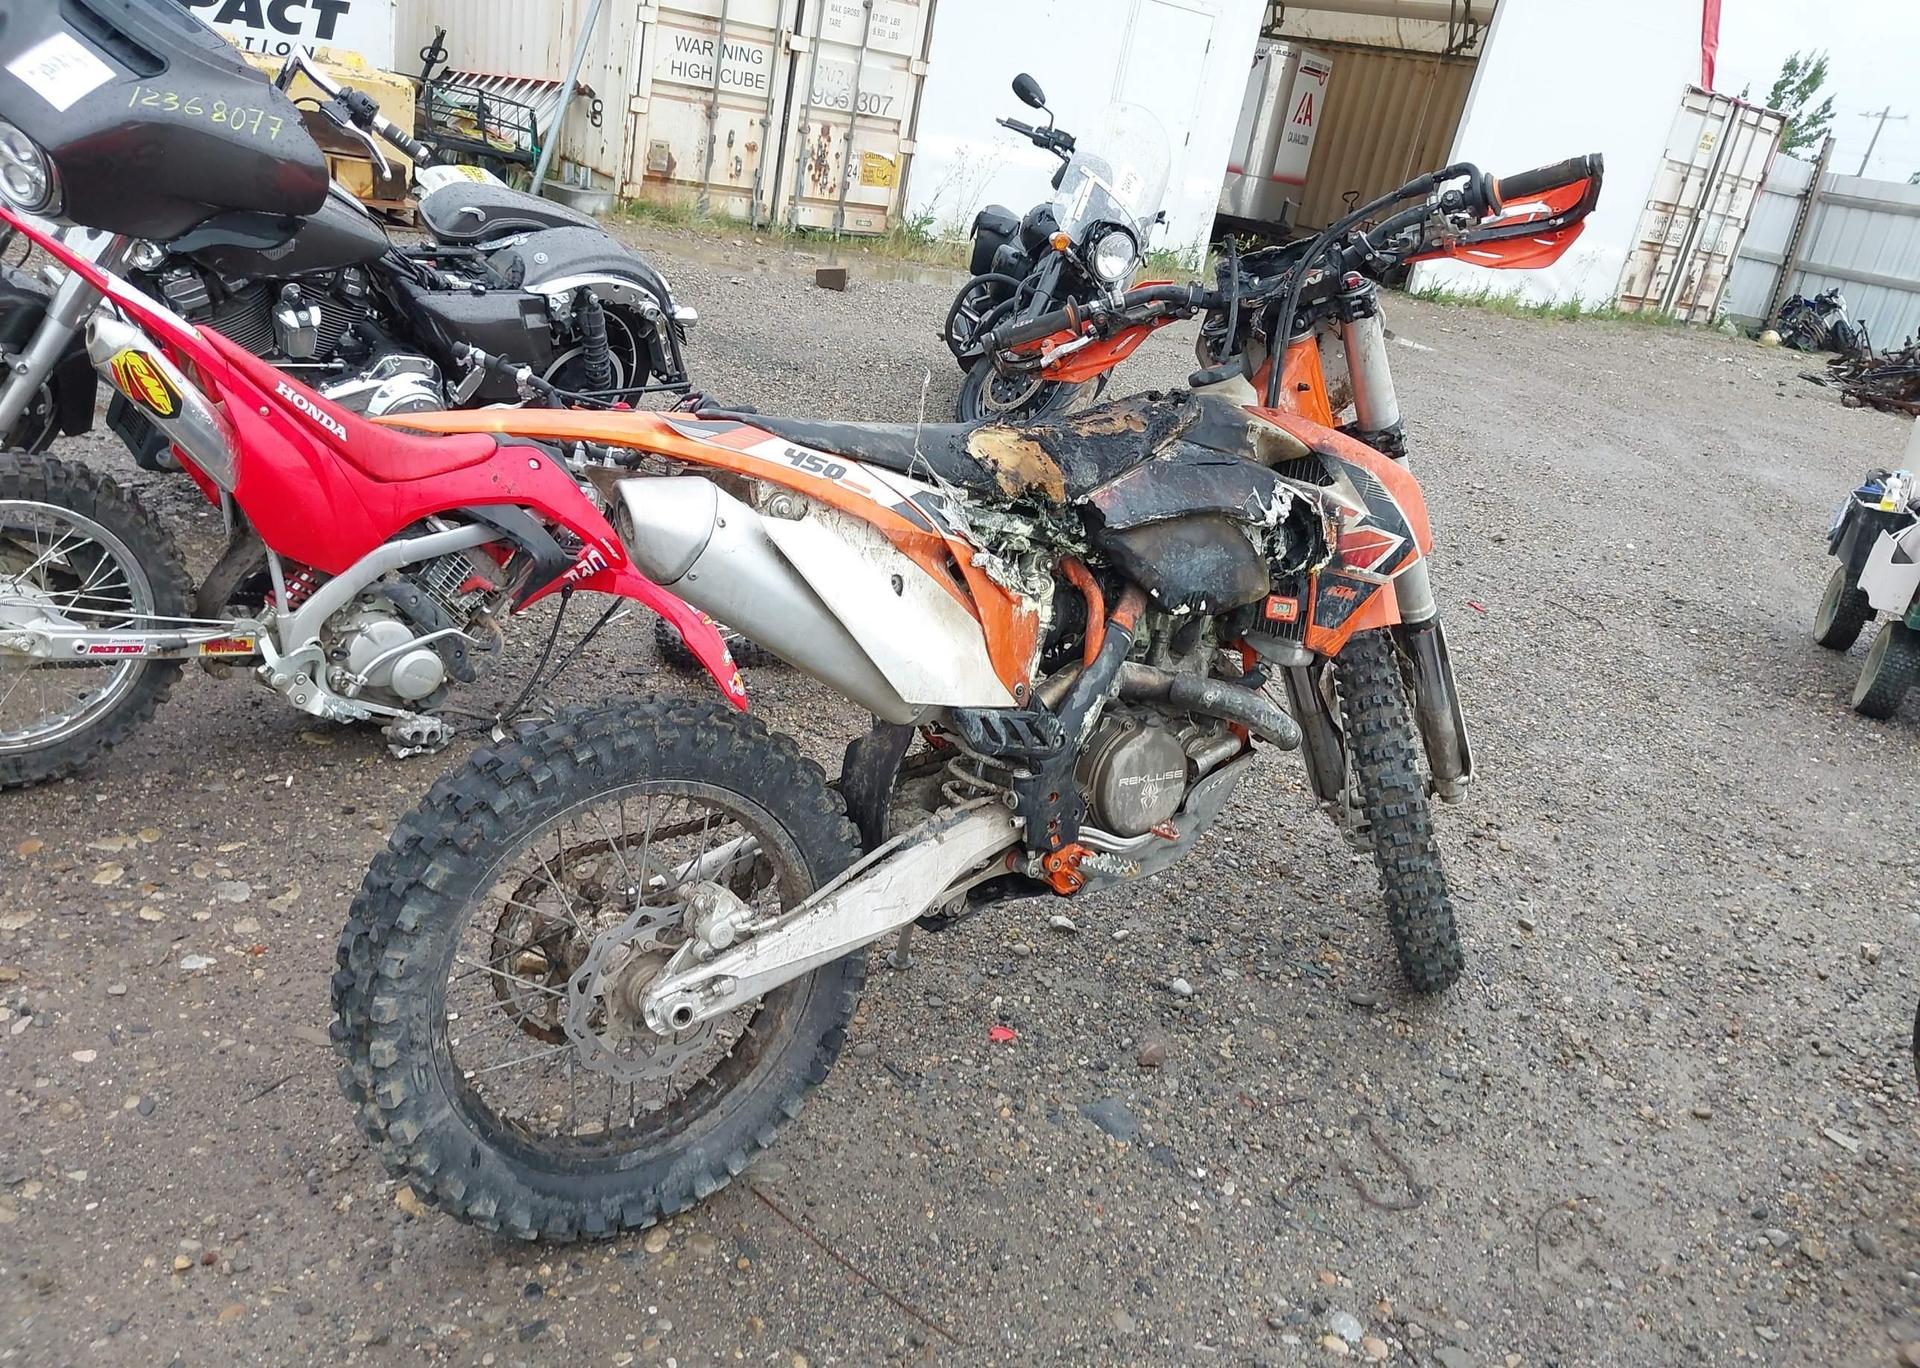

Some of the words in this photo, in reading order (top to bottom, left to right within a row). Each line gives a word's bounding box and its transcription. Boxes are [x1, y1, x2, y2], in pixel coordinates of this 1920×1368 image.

[177, 0, 350, 41] ACT
[675, 35, 763, 65] WARNING
[671, 60, 713, 82] HIGH
[720, 68, 766, 90] CUBE
[275, 381, 348, 442] HONDA
[784, 447, 847, 480] 450
[1327, 585, 1358, 600] KTM
[1119, 769, 1183, 787] REKLUSE
